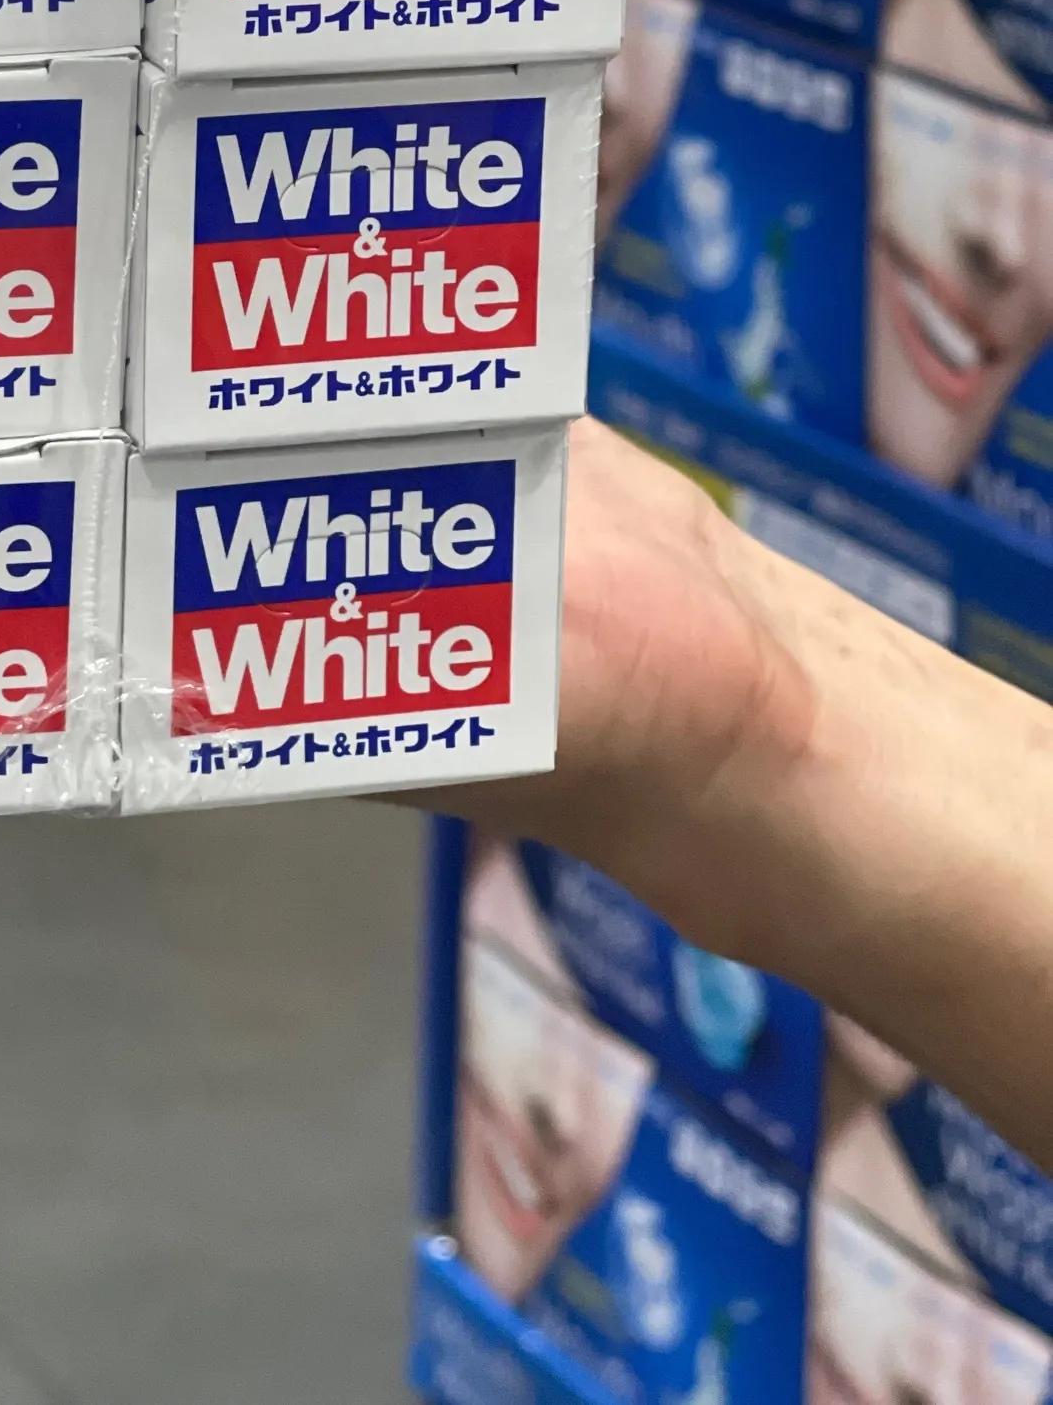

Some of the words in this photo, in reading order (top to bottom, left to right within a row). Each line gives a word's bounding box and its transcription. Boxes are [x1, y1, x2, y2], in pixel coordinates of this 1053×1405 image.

[216, 123, 524, 224] White
[353, 217, 388, 259] &
[212, 248, 519, 351] White
[208, 358, 521, 411] ホワイト&ホワイト
[195, 489, 496, 593] White
[329, 582, 364, 622] &
[192, 611, 493, 716] White
[189, 716, 495, 775] ホワイト&ホワイト
